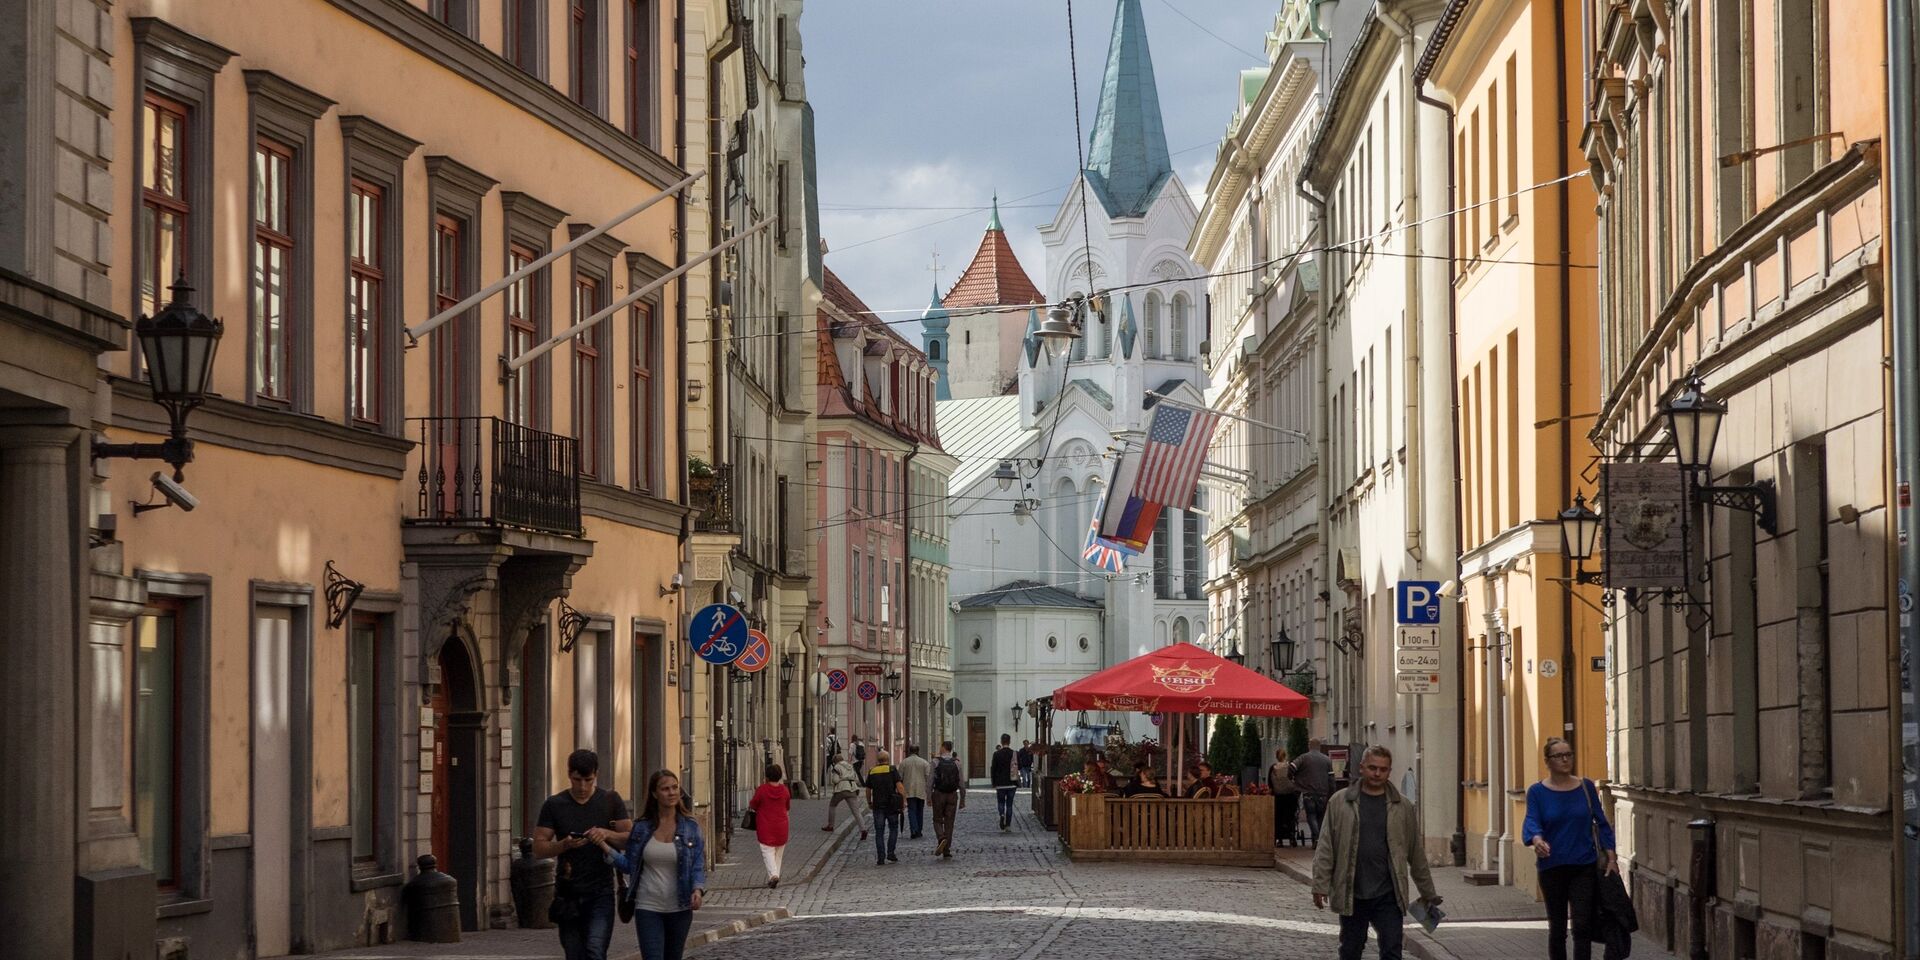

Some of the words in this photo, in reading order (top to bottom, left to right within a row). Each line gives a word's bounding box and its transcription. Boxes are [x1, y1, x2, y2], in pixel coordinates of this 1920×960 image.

[1407, 586, 1431, 619] P
[1408, 636, 1422, 644] 100
[1400, 656, 1438, 665] 6.00-24.00
[1235, 700, 1244, 709] ir
